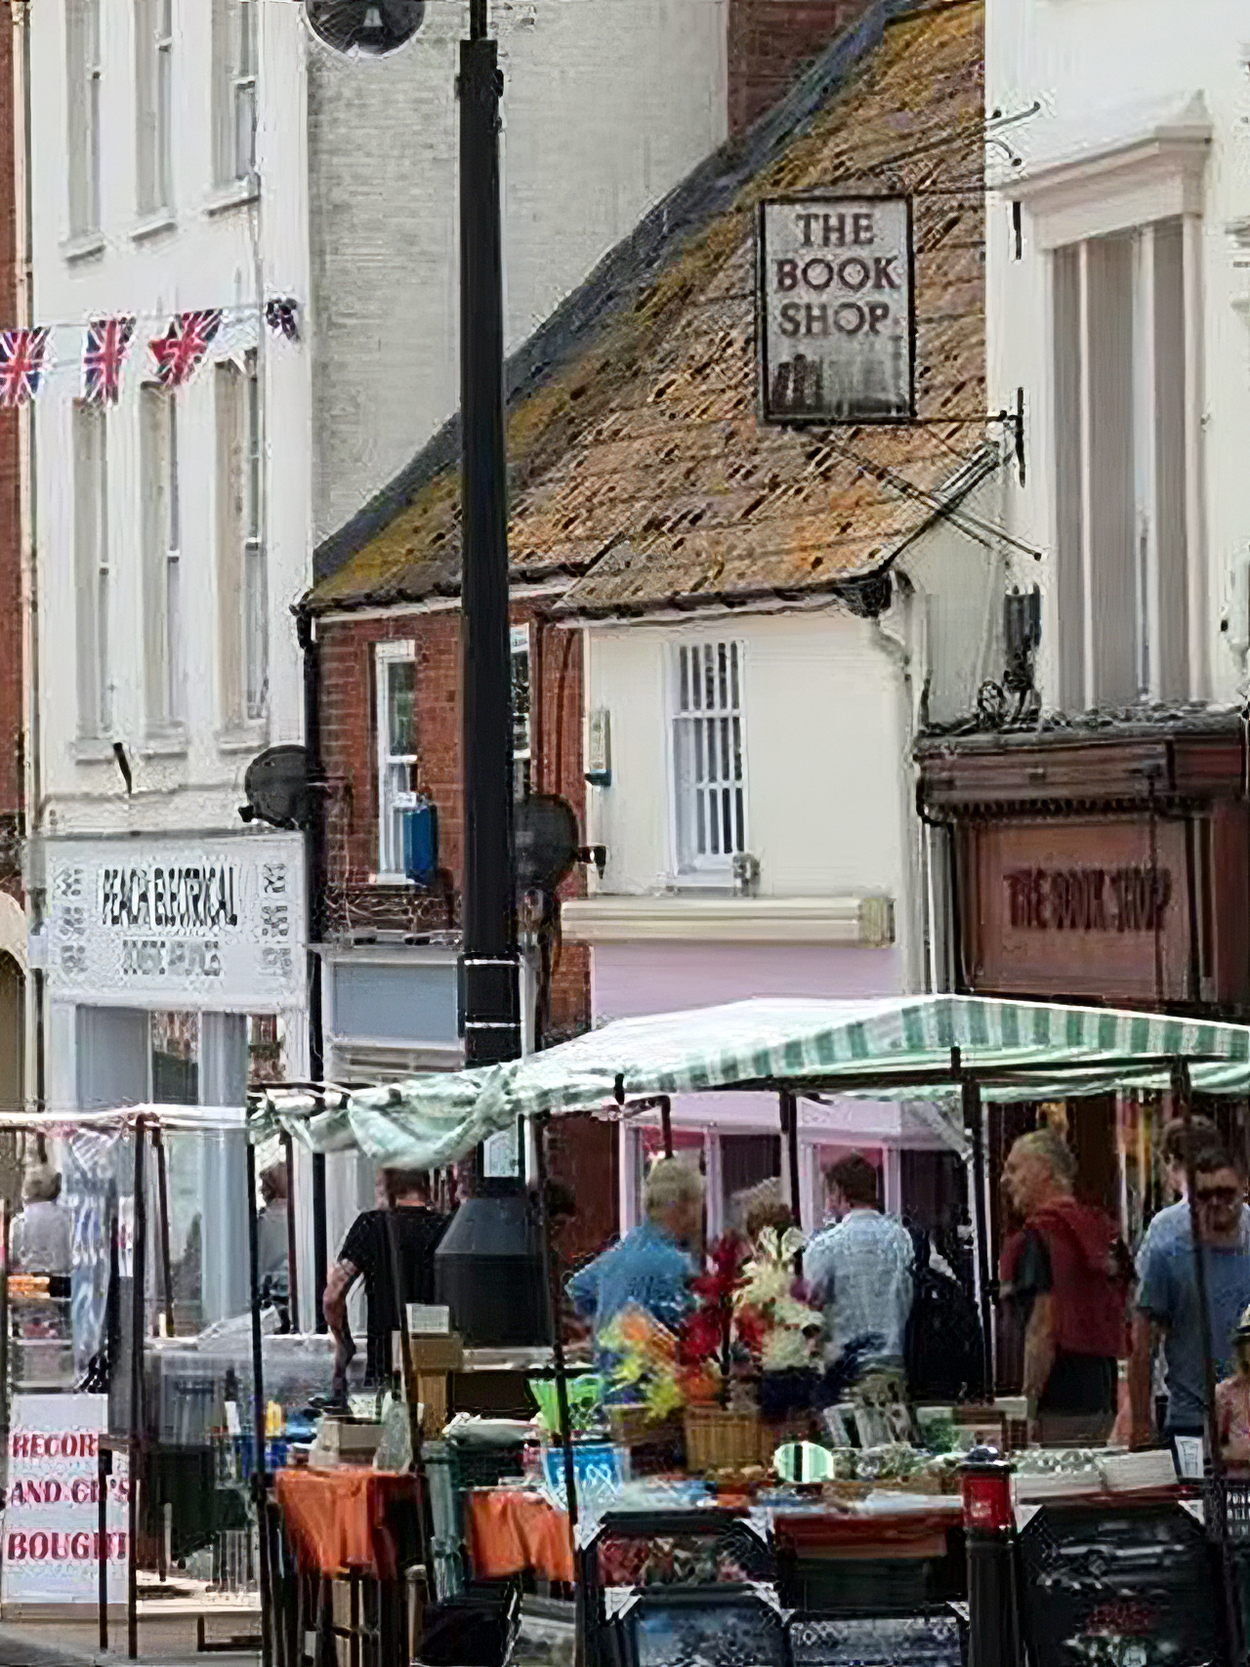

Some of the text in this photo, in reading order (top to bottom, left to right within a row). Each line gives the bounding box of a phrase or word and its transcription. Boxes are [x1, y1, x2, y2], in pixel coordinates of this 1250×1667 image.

[796, 212, 875, 247] THE
[772, 256, 900, 292] BOOK
[779, 300, 890, 337] SHOP
[1003, 868, 1047, 929] THE
[11, 1480, 62, 1504] AND
